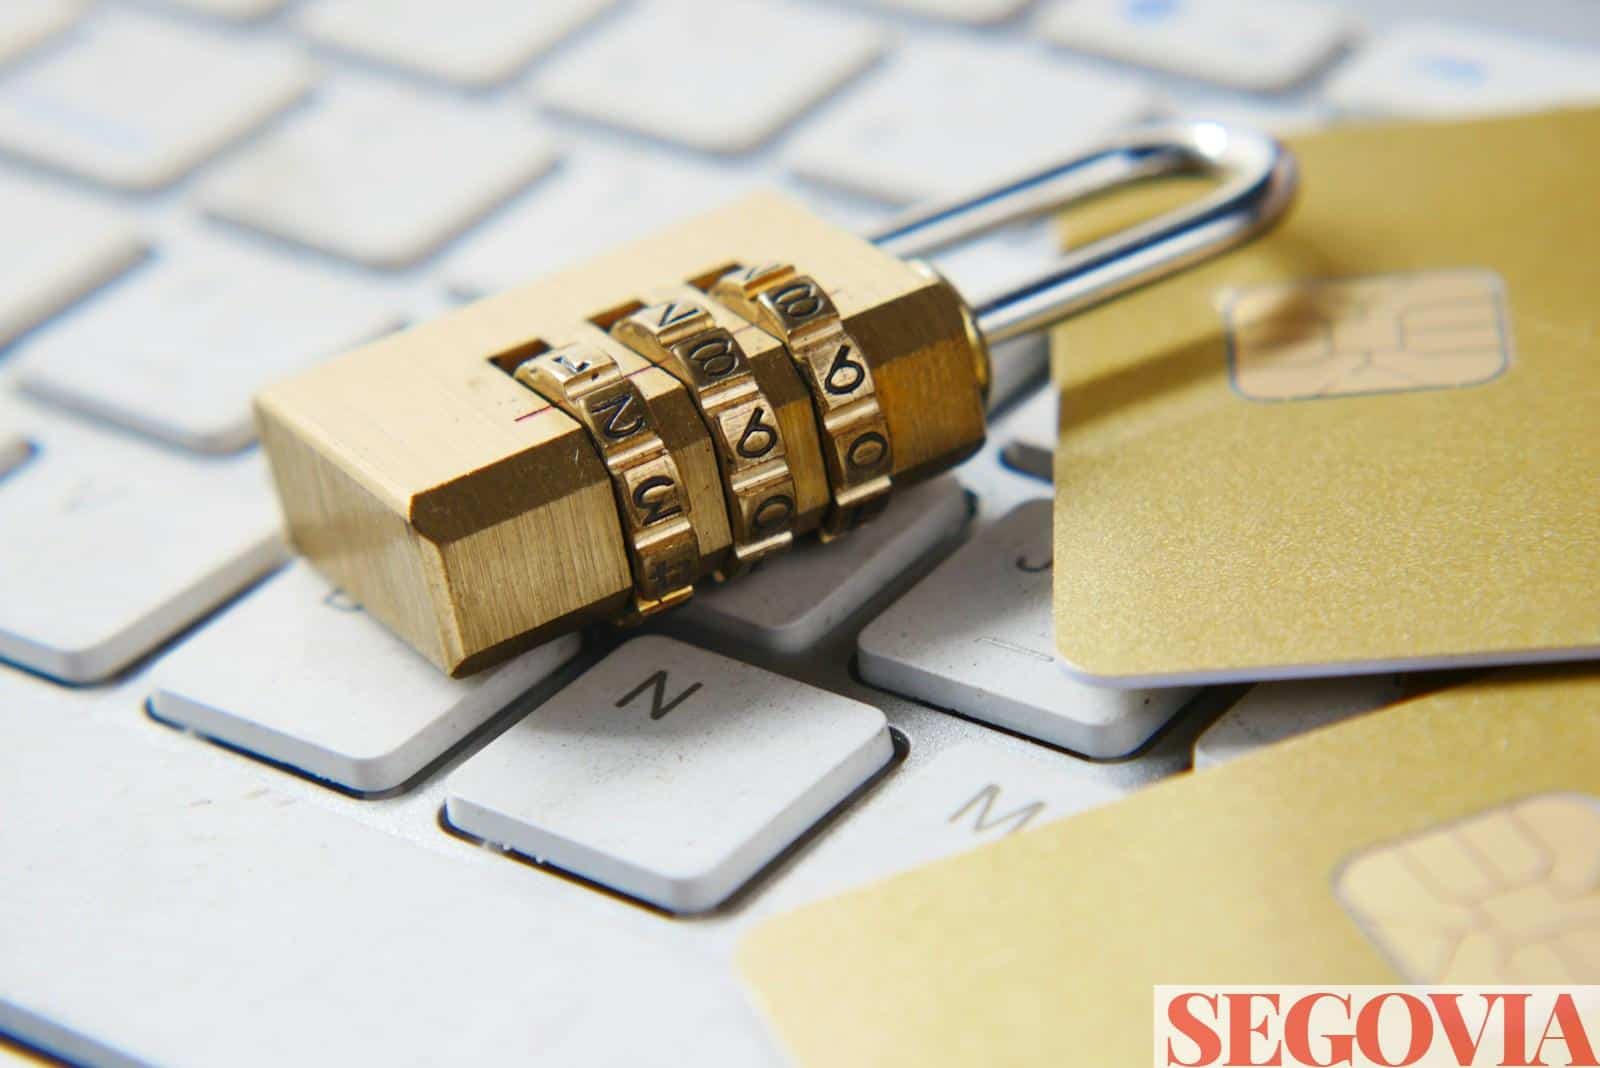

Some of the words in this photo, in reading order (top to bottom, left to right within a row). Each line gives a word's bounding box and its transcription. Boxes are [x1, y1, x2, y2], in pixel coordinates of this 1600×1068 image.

[773, 283, 824, 317] 8
[688, 336, 739, 377] 8
[614, 670, 703, 721] N
[949, 783, 1046, 833] M
